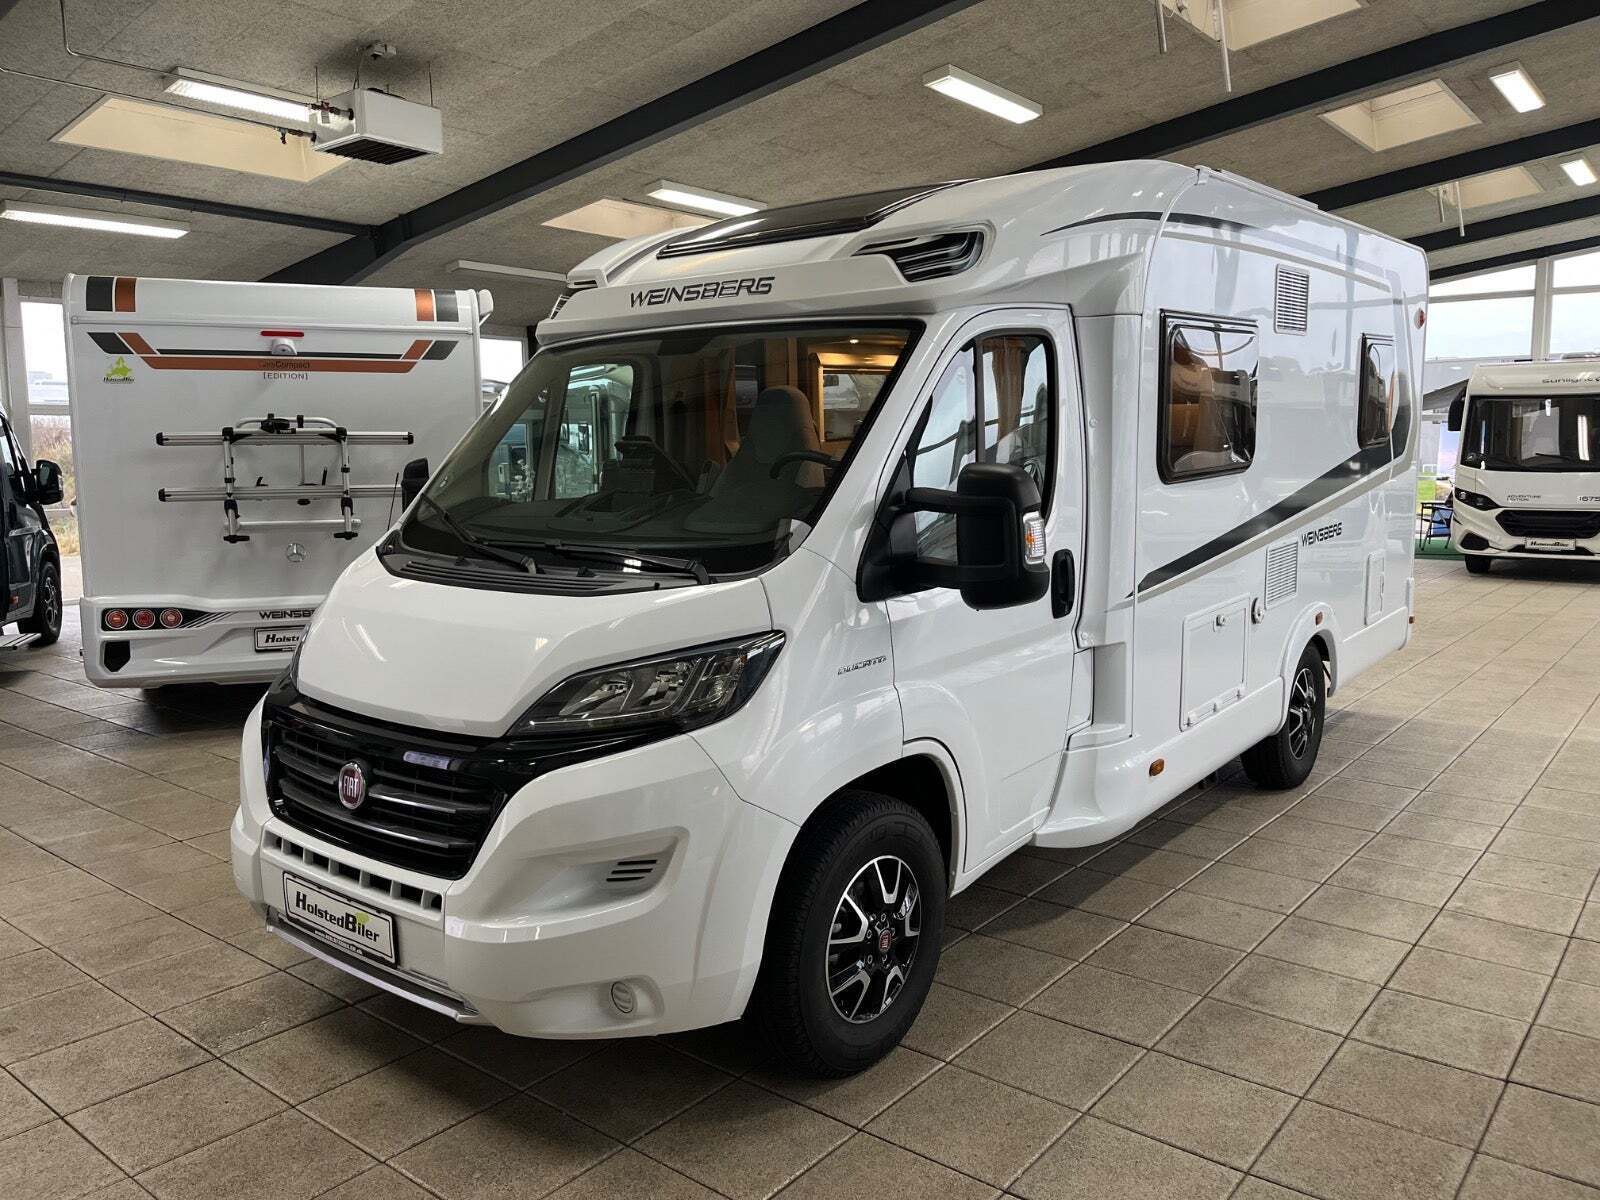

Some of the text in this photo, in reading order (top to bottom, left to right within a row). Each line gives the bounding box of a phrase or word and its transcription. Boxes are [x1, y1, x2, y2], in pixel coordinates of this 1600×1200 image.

[630, 276, 776, 308] WEINSBERG
[1302, 522, 1343, 547] WEINSBERG
[343, 775, 359, 798] FIAT
[295, 890, 380, 943] HolstedBiler
